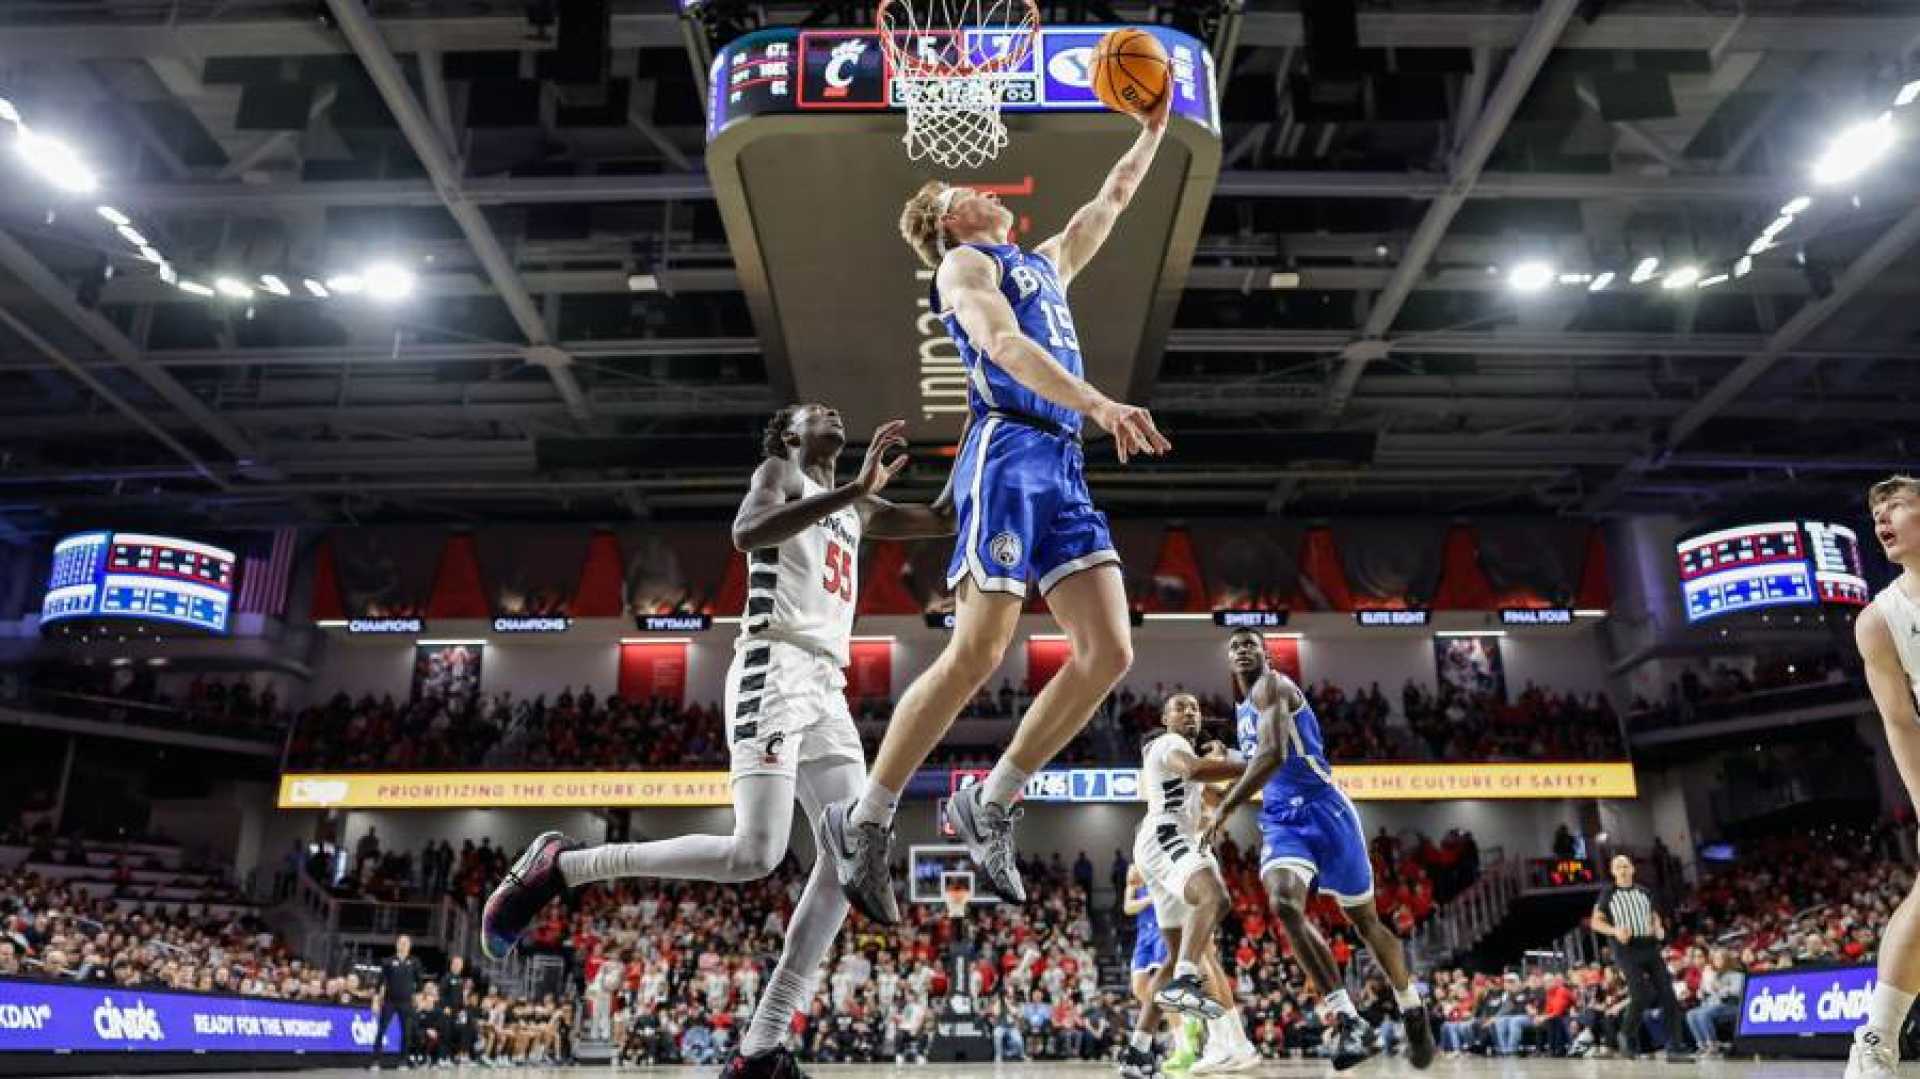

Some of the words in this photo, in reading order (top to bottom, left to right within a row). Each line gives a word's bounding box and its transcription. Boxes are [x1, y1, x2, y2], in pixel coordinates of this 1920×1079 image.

[1040, 300, 1080, 351] 15
[823, 543, 852, 602] 55
[377, 784, 505, 799] PRIORITIZING
[511, 784, 545, 798] THE
[552, 784, 634, 798] CULTURE
[641, 784, 664, 797] OF
[1370, 775, 1402, 790] THE
[1410, 775, 1492, 790] CULTURE
[1501, 774, 1521, 789] OF
[1530, 774, 1600, 788] SAFETY
